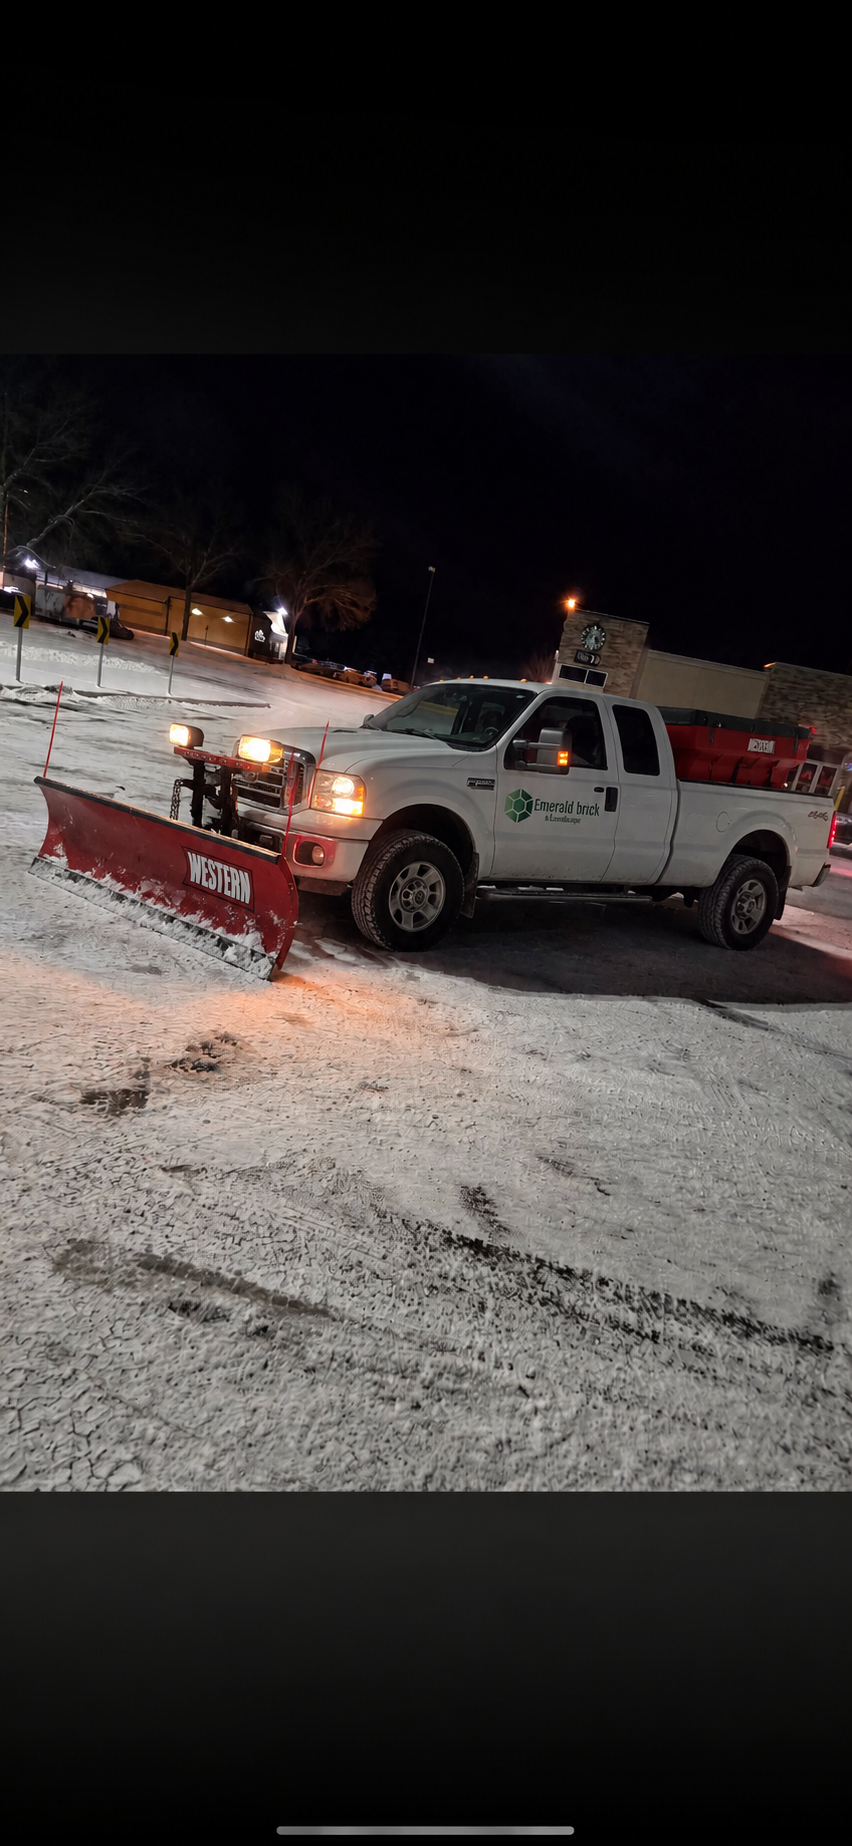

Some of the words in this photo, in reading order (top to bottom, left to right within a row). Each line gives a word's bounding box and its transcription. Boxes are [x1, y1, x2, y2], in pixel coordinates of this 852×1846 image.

[534, 798, 574, 814] Emerald
[576, 801, 600, 817] brick
[187, 851, 251, 905] WESTERN
